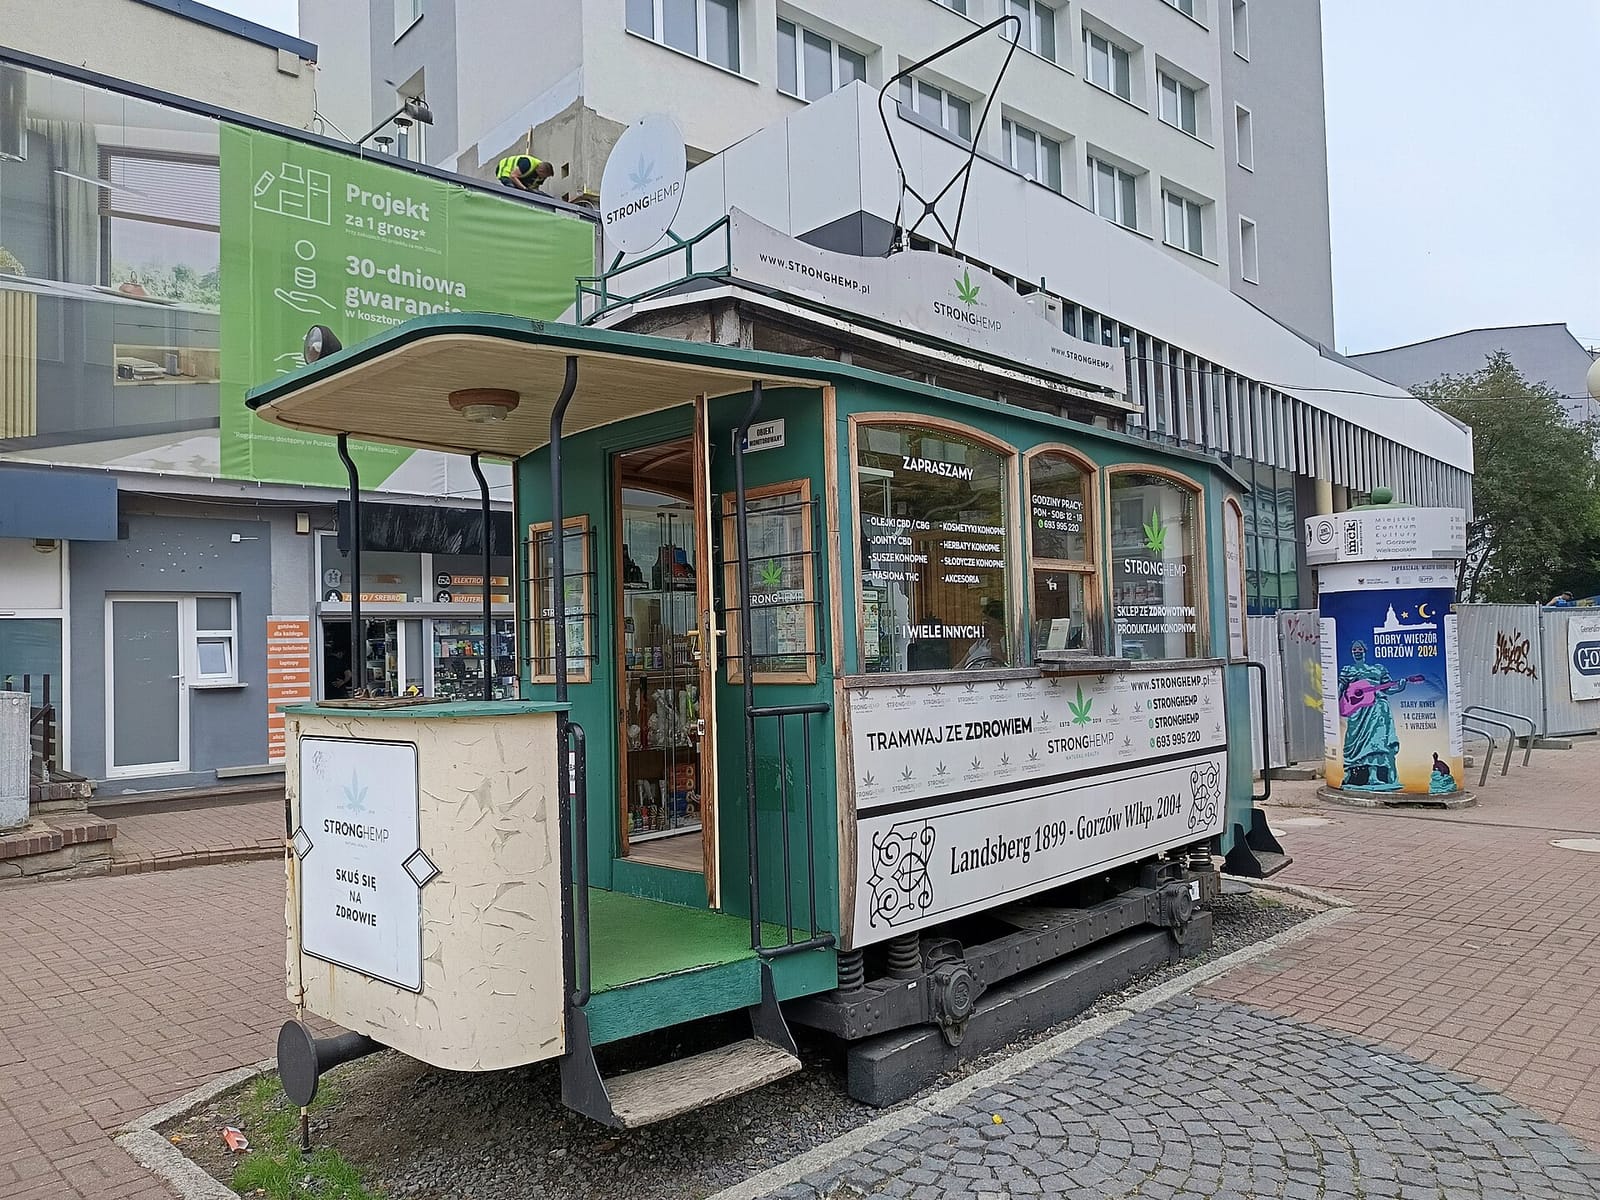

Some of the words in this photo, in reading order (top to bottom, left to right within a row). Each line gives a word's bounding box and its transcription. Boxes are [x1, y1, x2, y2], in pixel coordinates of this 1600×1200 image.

[346, 183, 430, 222] Projekt
[606, 181, 680, 224] STRONGHEMP
[345, 214, 364, 228] za
[367, 217, 374, 230] 1
[345, 256, 466, 298] 30-dniowa
[759, 253, 870, 294] www.STRONGHEMP.pl
[345, 309, 355, 318] w
[933, 301, 1001, 332] STRONGHEMP
[757, 427, 774, 436] OBIEKT
[902, 455, 974, 481] ZAPRASZAMY
[1032, 495, 1060, 507] GODZINY
[1033, 508, 1046, 517] PON
[1066, 512, 1073, 521] 12
[1044, 520, 1055, 529] 693
[1056, 521, 1067, 531] 995
[1068, 523, 1079, 532] 220
[1124, 558, 1187, 577] STRONGHEMP
[905, 572, 919, 581] THC
[945, 574, 980, 583] AKCESORIA
[375, 593, 401, 601] SREBRO
[1117, 606, 1138, 617] SKLEP
[1139, 606, 1148, 616] ZE
[907, 625, 941, 638] WIELE
[943, 625, 980, 639] INNYCH
[1117, 624, 1160, 635] PRODUKTAMI
[1374, 634, 1401, 645] DOBRY
[1404, 631, 1437, 644] WIECZÓR
[1374, 644, 1414, 658] GORZÓW
[1418, 645, 1437, 657] 2024
[1131, 674, 1209, 692] www.STRONGHEMP.pl
[1153, 694, 1198, 710] STRONGHEMP
[1419, 700, 1435, 708] RYNEK
[1155, 712, 1200, 729] STRONGHEMP
[1412, 712, 1436, 720] CZERWCA
[1411, 721, 1437, 730] WRZEŚNIA
[866, 726, 942, 752] TRAMWAJ
[946, 724, 963, 742] ZE
[965, 717, 1032, 741] ZDROWIEM
[1047, 731, 1115, 754] STRONGHEMP
[1156, 734, 1171, 748] 693
[1172, 732, 1186, 746] 995
[1187, 730, 1201, 743] 220
[323, 818, 389, 844] STRONGHEMP
[950, 834, 1031, 875] Landsberg
[1034, 820, 1067, 853] 1899
[1077, 808, 1122, 841] Gorzów
[1124, 800, 1155, 829] Wlkp.
[1156, 792, 1182, 820] 2004
[335, 868, 360, 885] SKUŚ
[361, 874, 377, 892] SIĘ
[349, 890, 362, 904] NA
[335, 904, 377, 927] ZDROWIE
